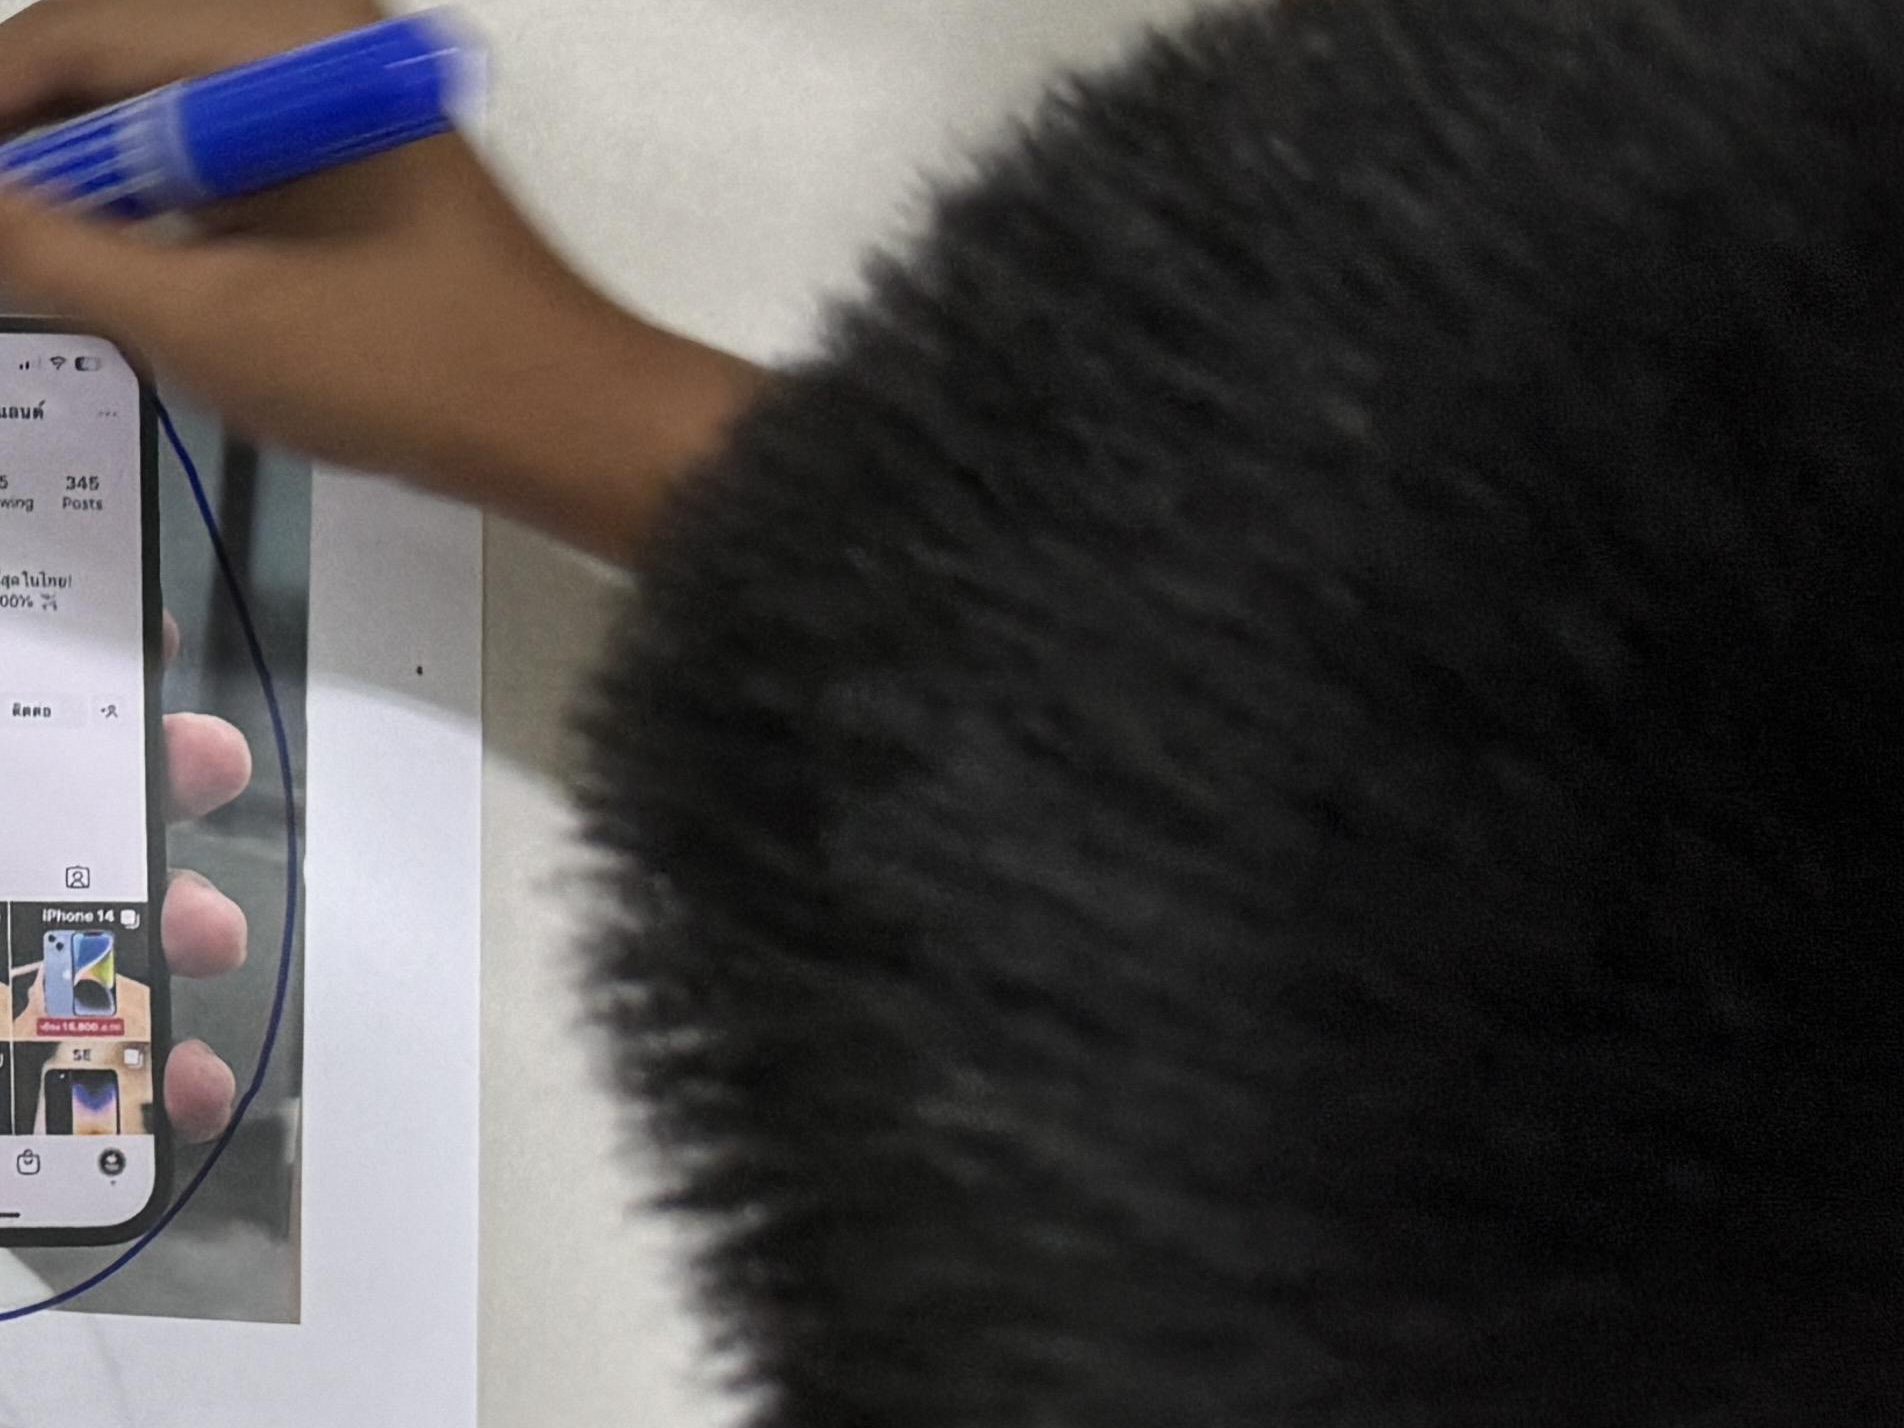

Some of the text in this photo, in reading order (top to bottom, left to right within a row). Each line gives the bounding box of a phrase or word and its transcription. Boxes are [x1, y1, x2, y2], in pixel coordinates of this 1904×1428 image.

[66, 476, 99, 491] 345
[62, 497, 103, 511] Posts
[42, 908, 115, 922] iPhone 14
